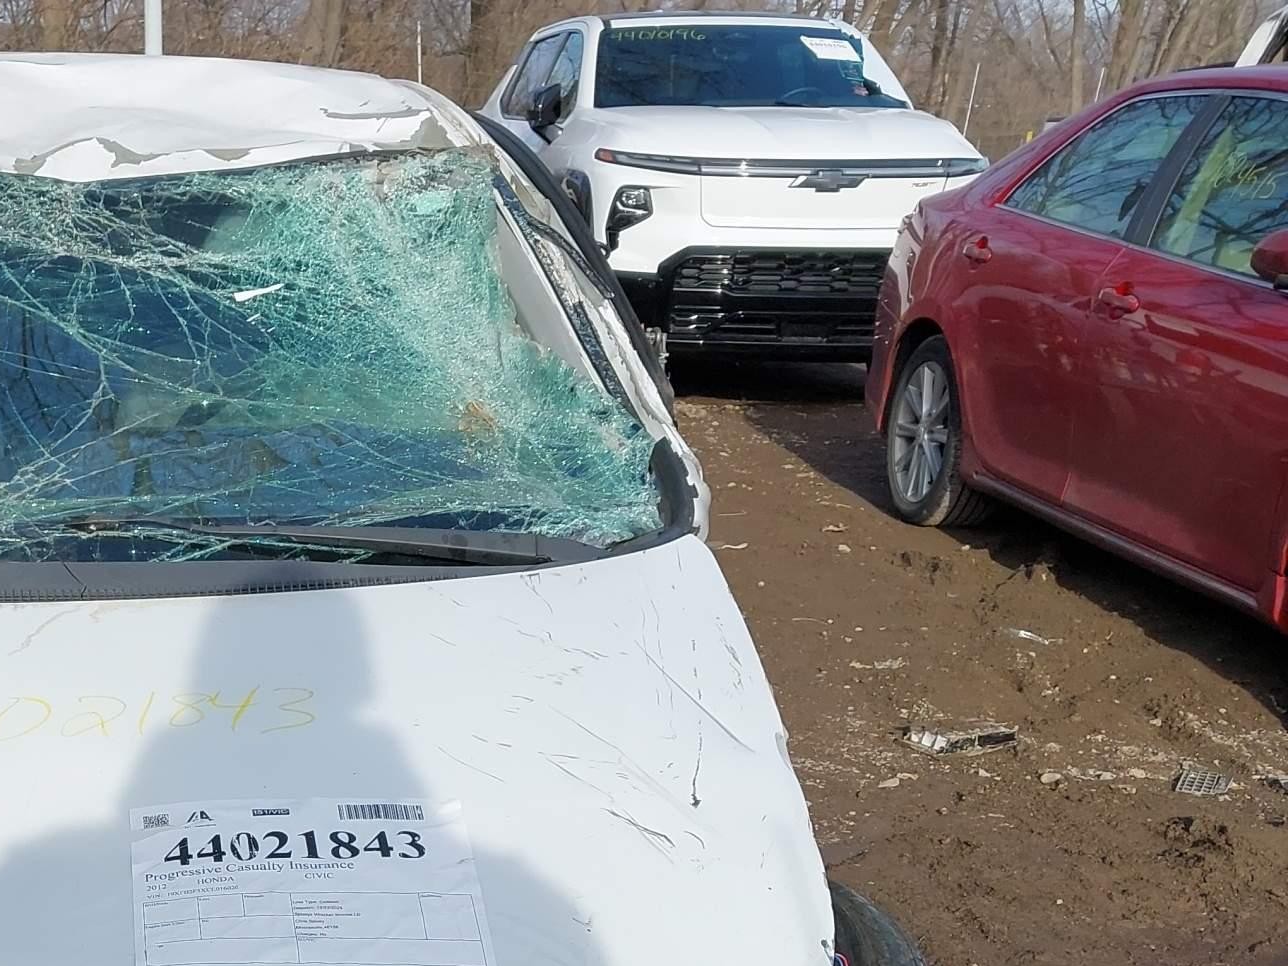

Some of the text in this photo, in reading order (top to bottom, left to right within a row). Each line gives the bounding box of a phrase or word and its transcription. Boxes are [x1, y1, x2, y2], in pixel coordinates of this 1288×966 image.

[163, 829, 427, 866] 44021843
[144, 860, 355, 883] Progressive Casualty Insurance
[146, 884, 167, 892] 2012
[197, 876, 235, 885] HONDA
